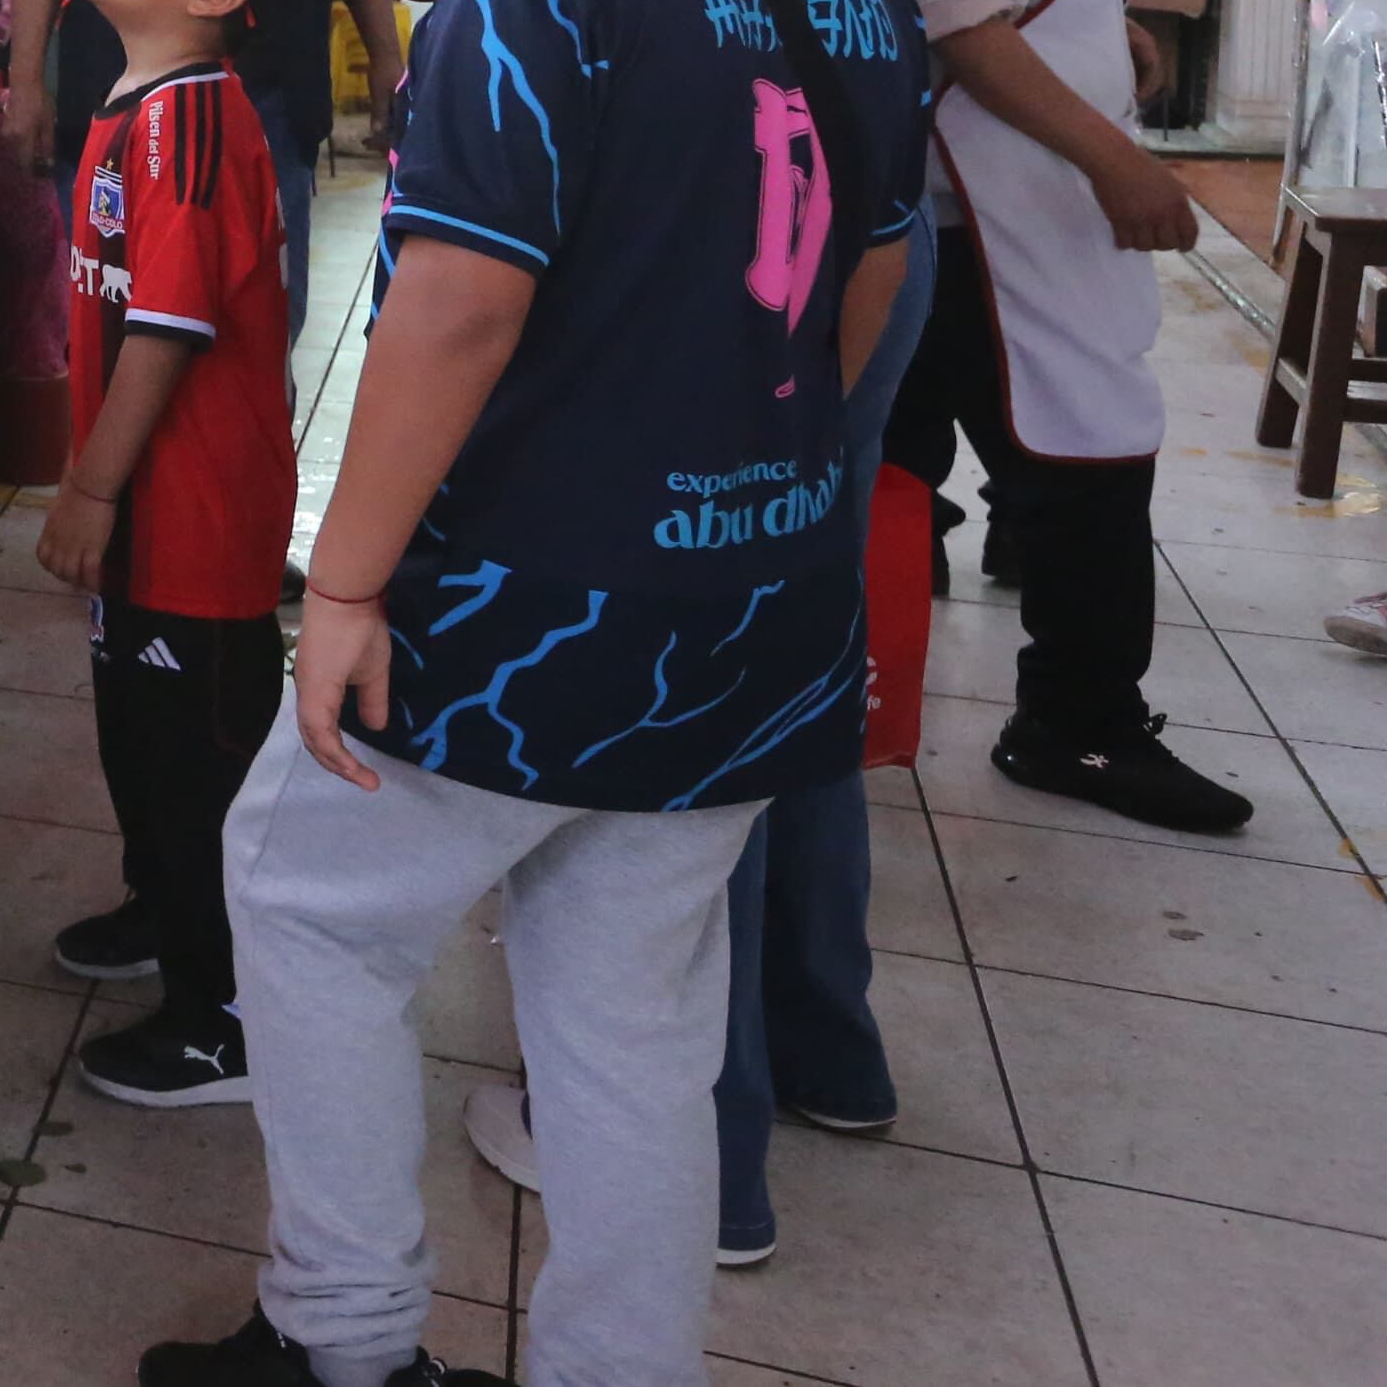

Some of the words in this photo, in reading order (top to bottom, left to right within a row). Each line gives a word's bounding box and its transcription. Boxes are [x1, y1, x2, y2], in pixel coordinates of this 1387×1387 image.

[149, 100, 164, 137] Pilsen
[148, 138, 159, 154] del
[147, 155, 161, 180] Sur
[666, 459, 797, 498] experience
[653, 499, 754, 550] abu
[762, 460, 843, 538] dhab
